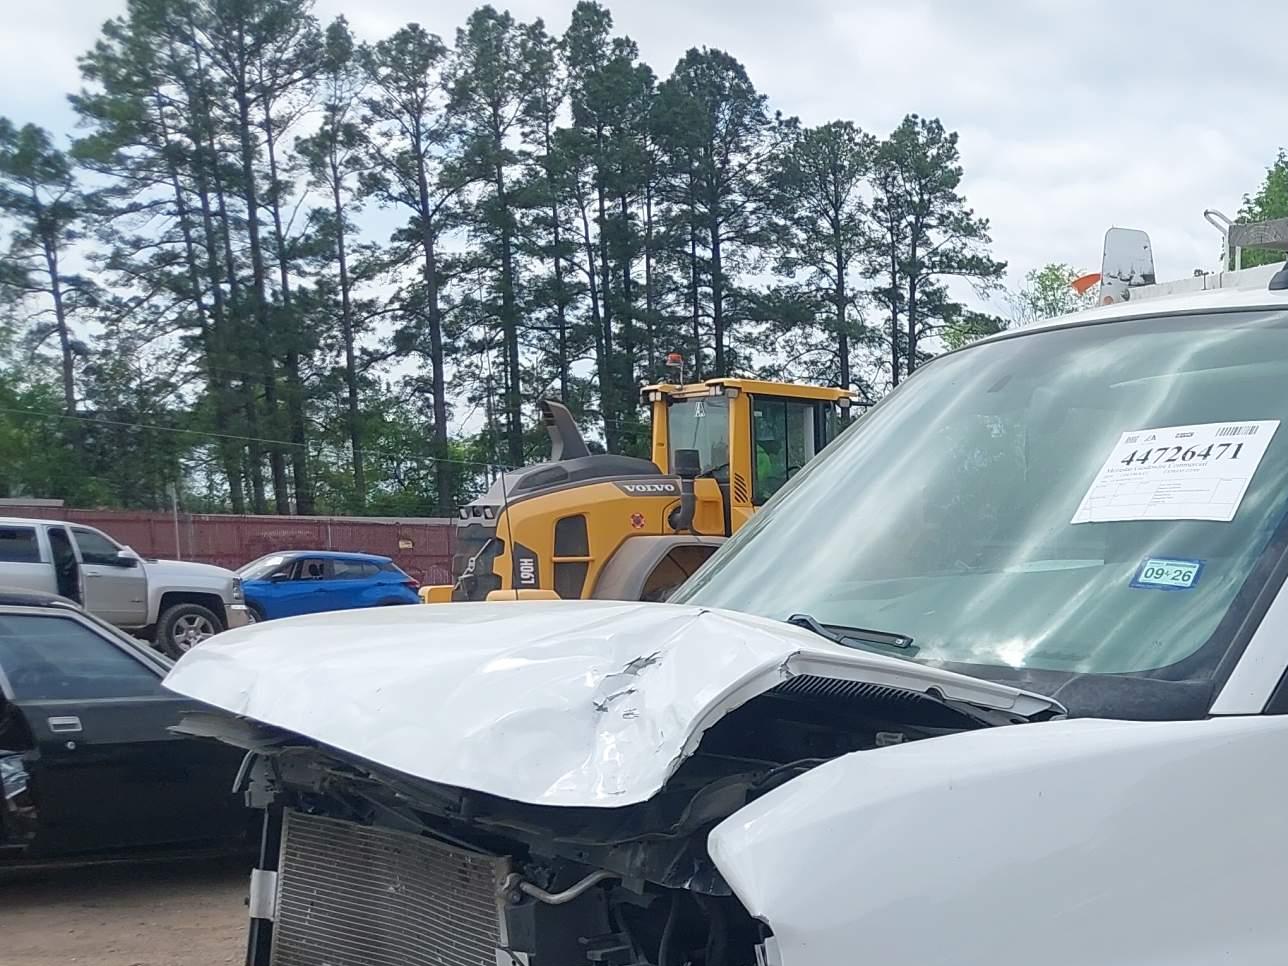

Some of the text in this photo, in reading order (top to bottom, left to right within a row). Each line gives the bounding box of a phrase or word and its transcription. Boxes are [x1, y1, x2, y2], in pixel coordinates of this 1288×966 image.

[1121, 442, 1244, 466] 44726471
[623, 484, 675, 492] VOLVO
[519, 558, 535, 584] L90H
[1144, 567, 1193, 582] 09 26
